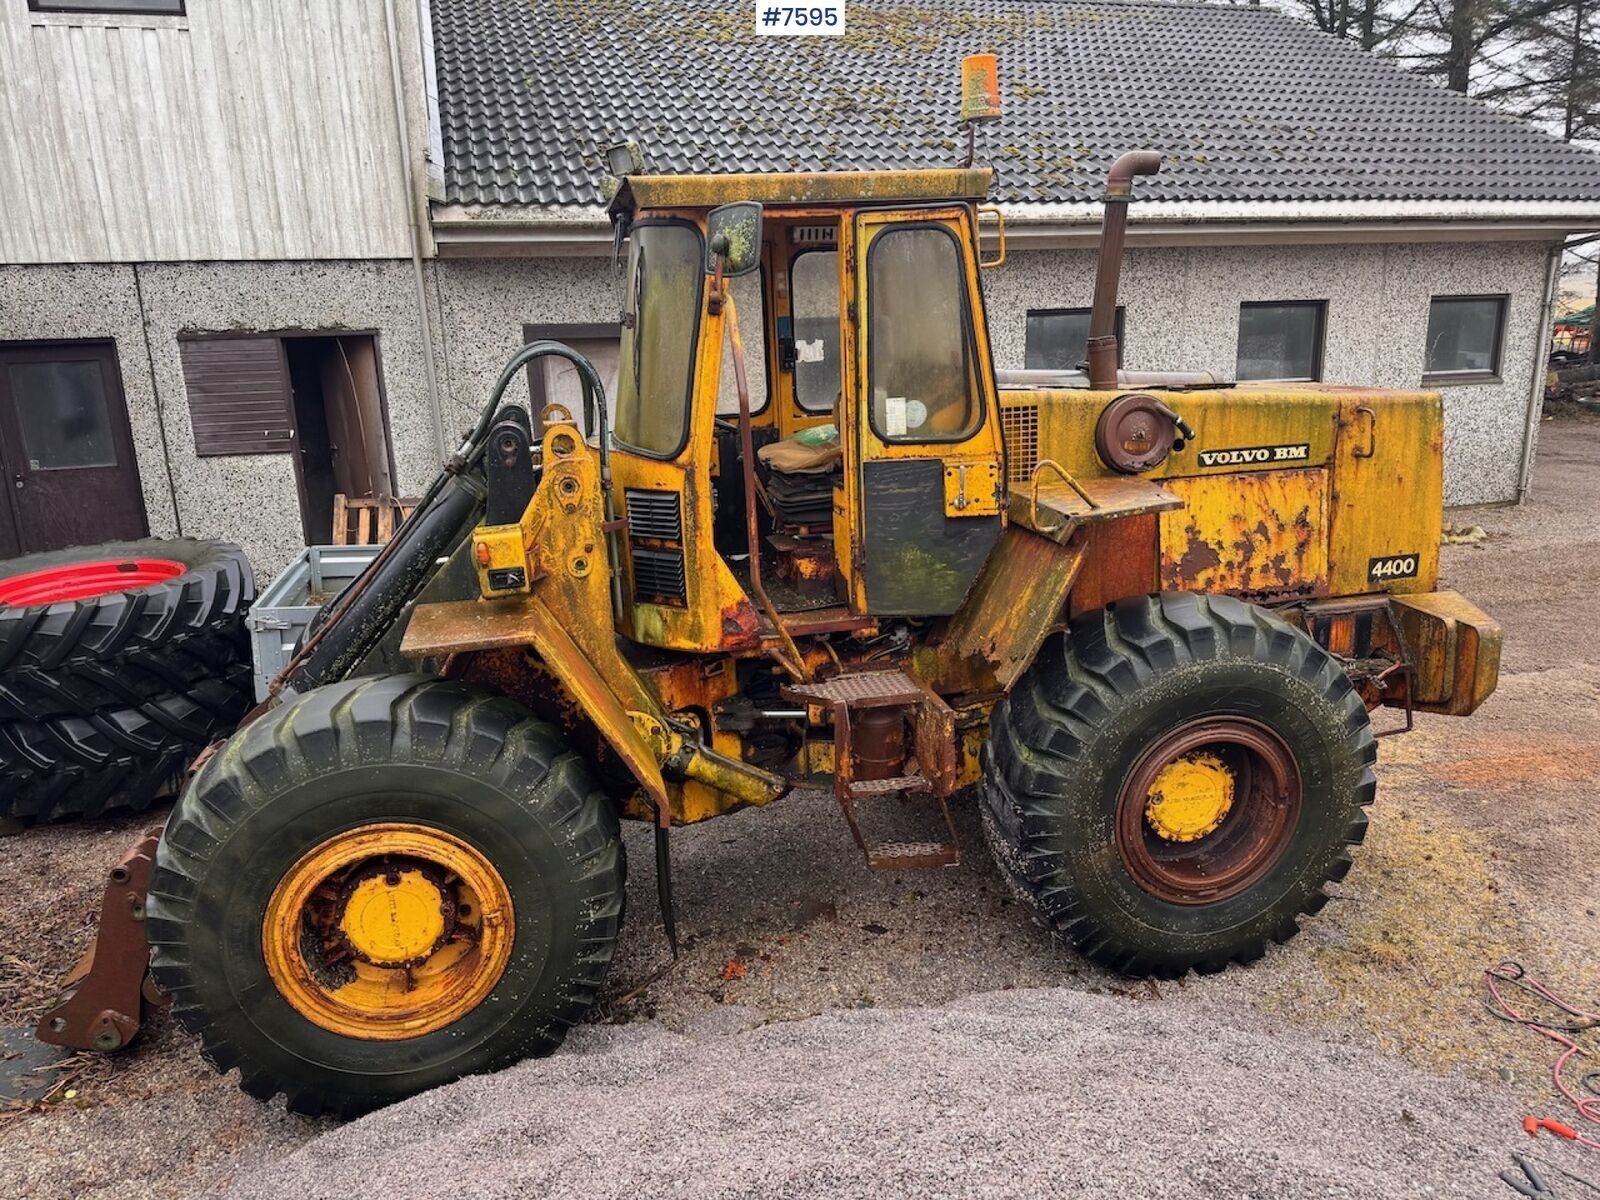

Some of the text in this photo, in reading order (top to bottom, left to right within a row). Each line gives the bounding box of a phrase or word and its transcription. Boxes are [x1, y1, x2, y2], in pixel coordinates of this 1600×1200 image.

[1200, 445, 1307, 465] VOLVO BM
[1371, 557, 1415, 577] 4400
